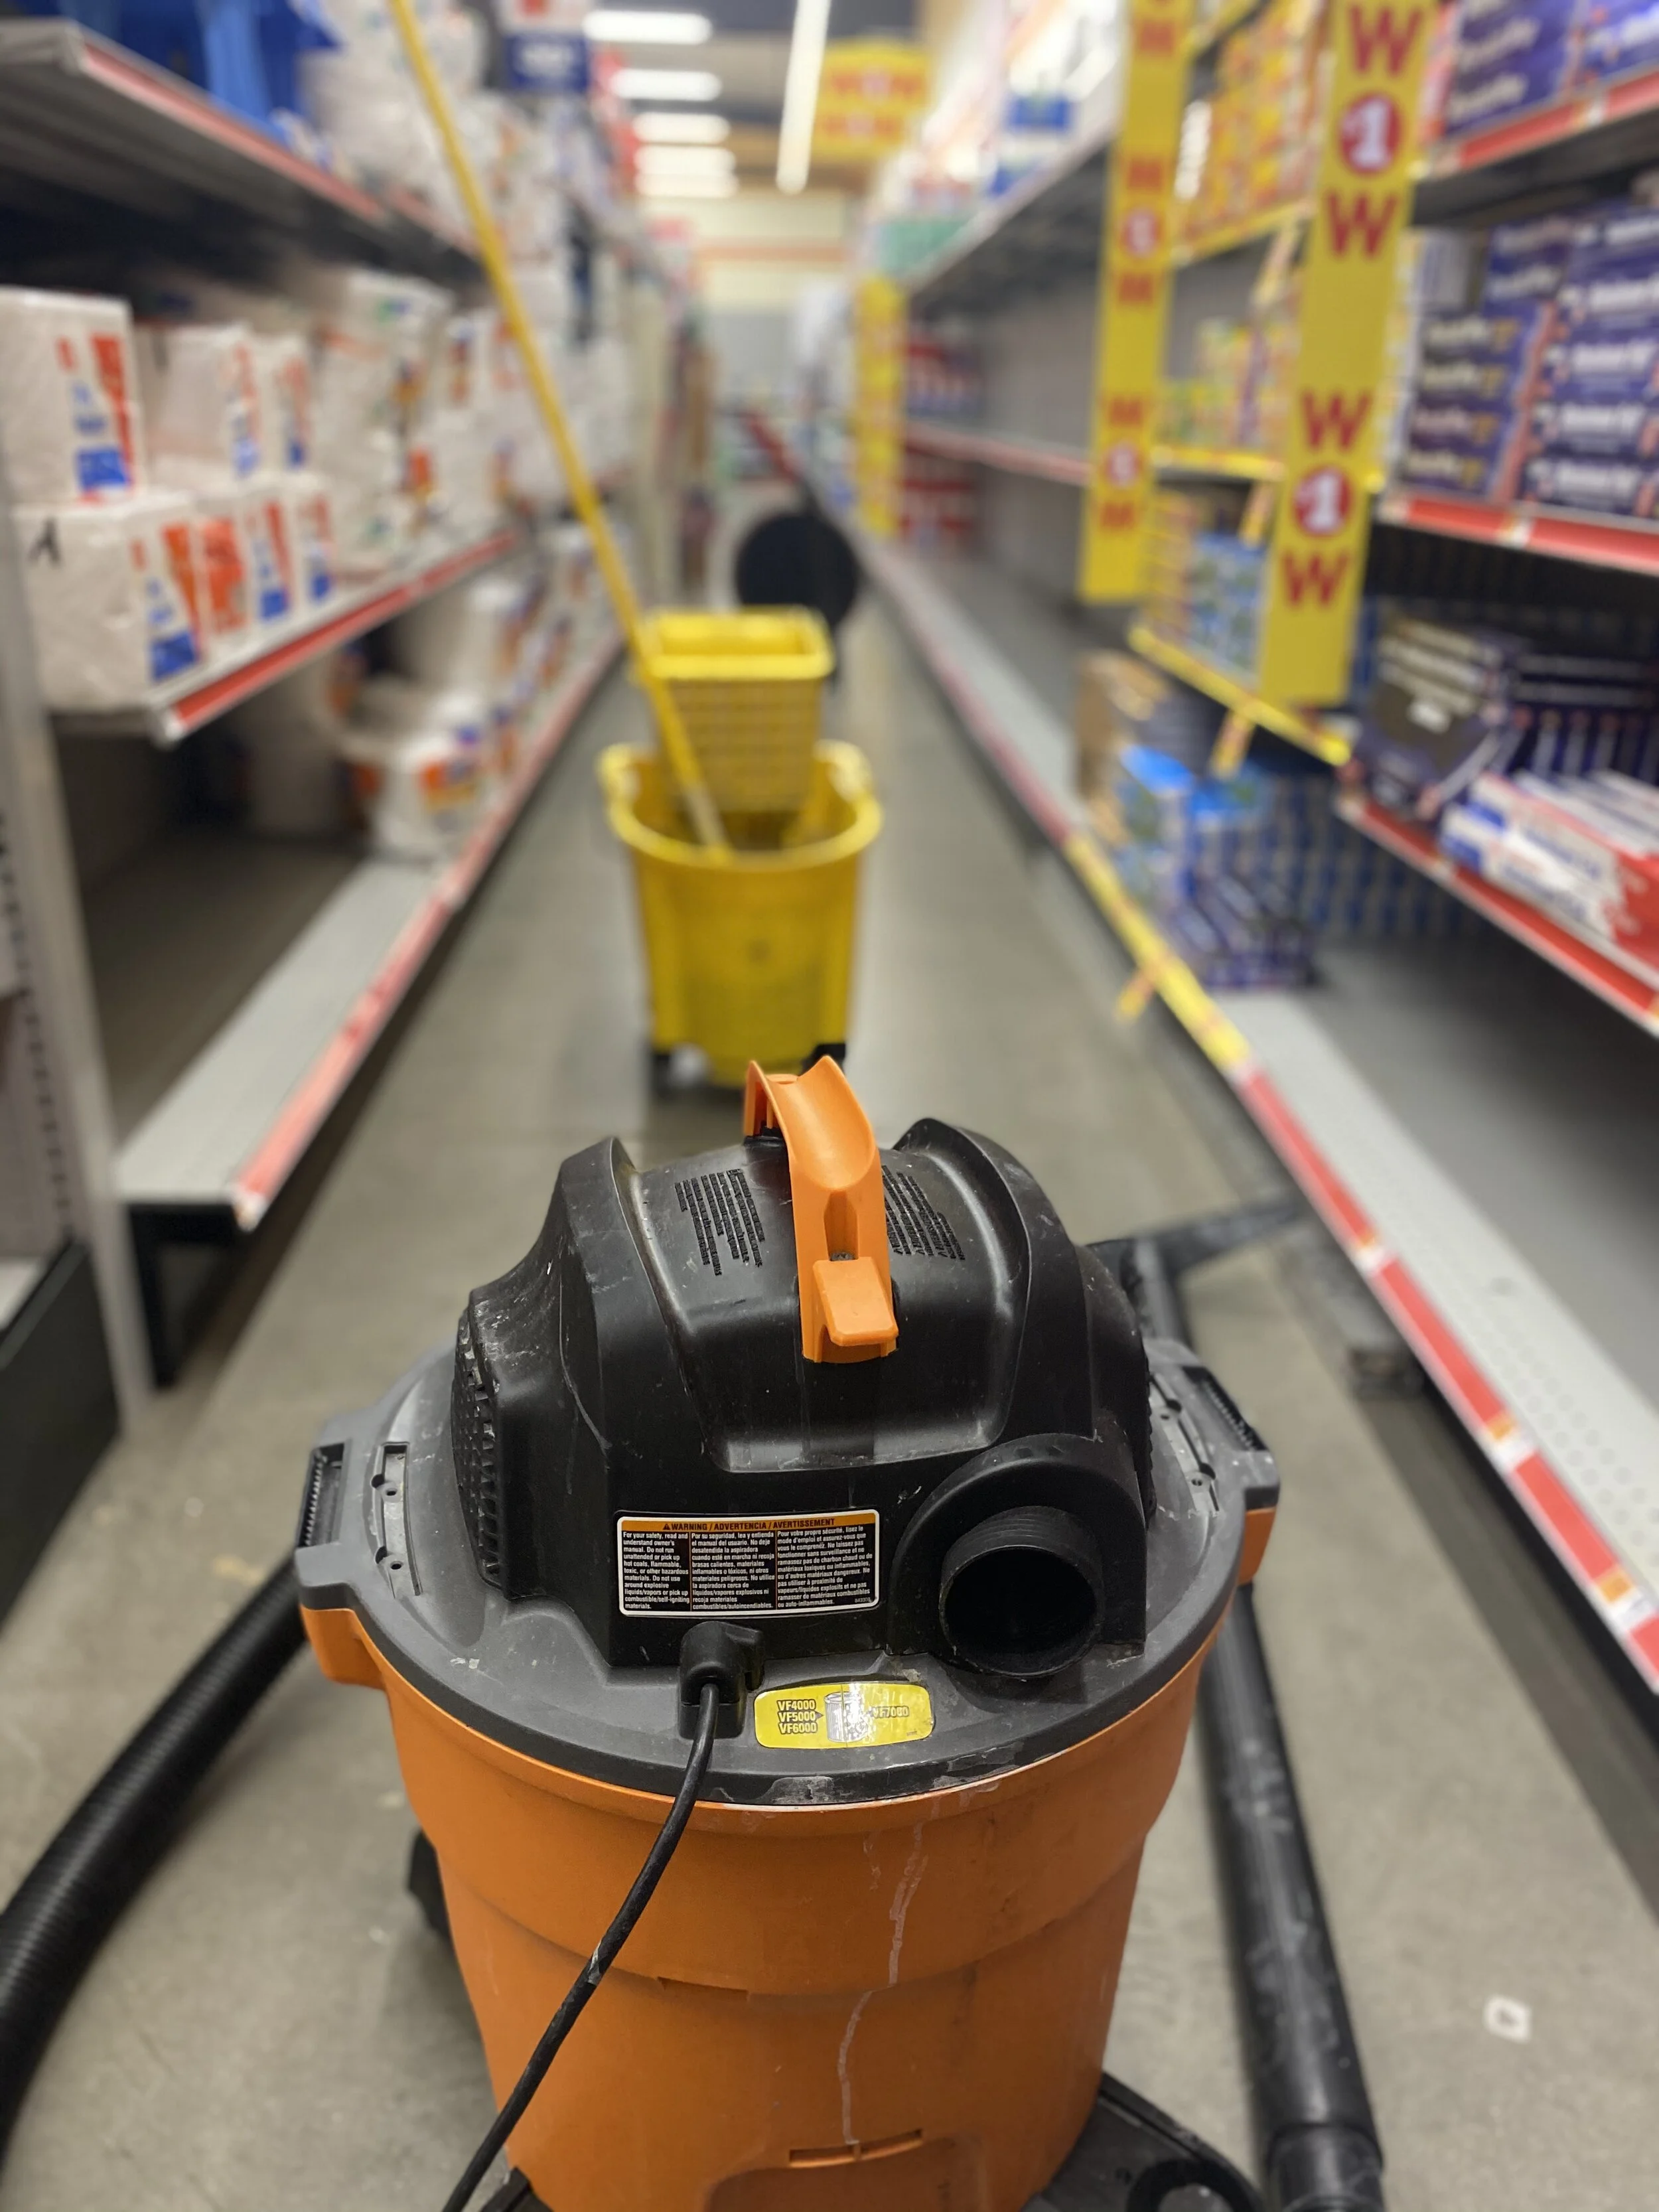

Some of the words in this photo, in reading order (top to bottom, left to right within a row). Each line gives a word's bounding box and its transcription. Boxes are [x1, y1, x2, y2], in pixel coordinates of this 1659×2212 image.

[714, 1522, 766, 1530] ADVERTENCIA
[773, 1518, 835, 1528] AVERTISSEMENT
[777, 1699, 816, 1711] VF4000
[778, 1711, 816, 1722] VF5000
[778, 1722, 818, 1734] VF6000
